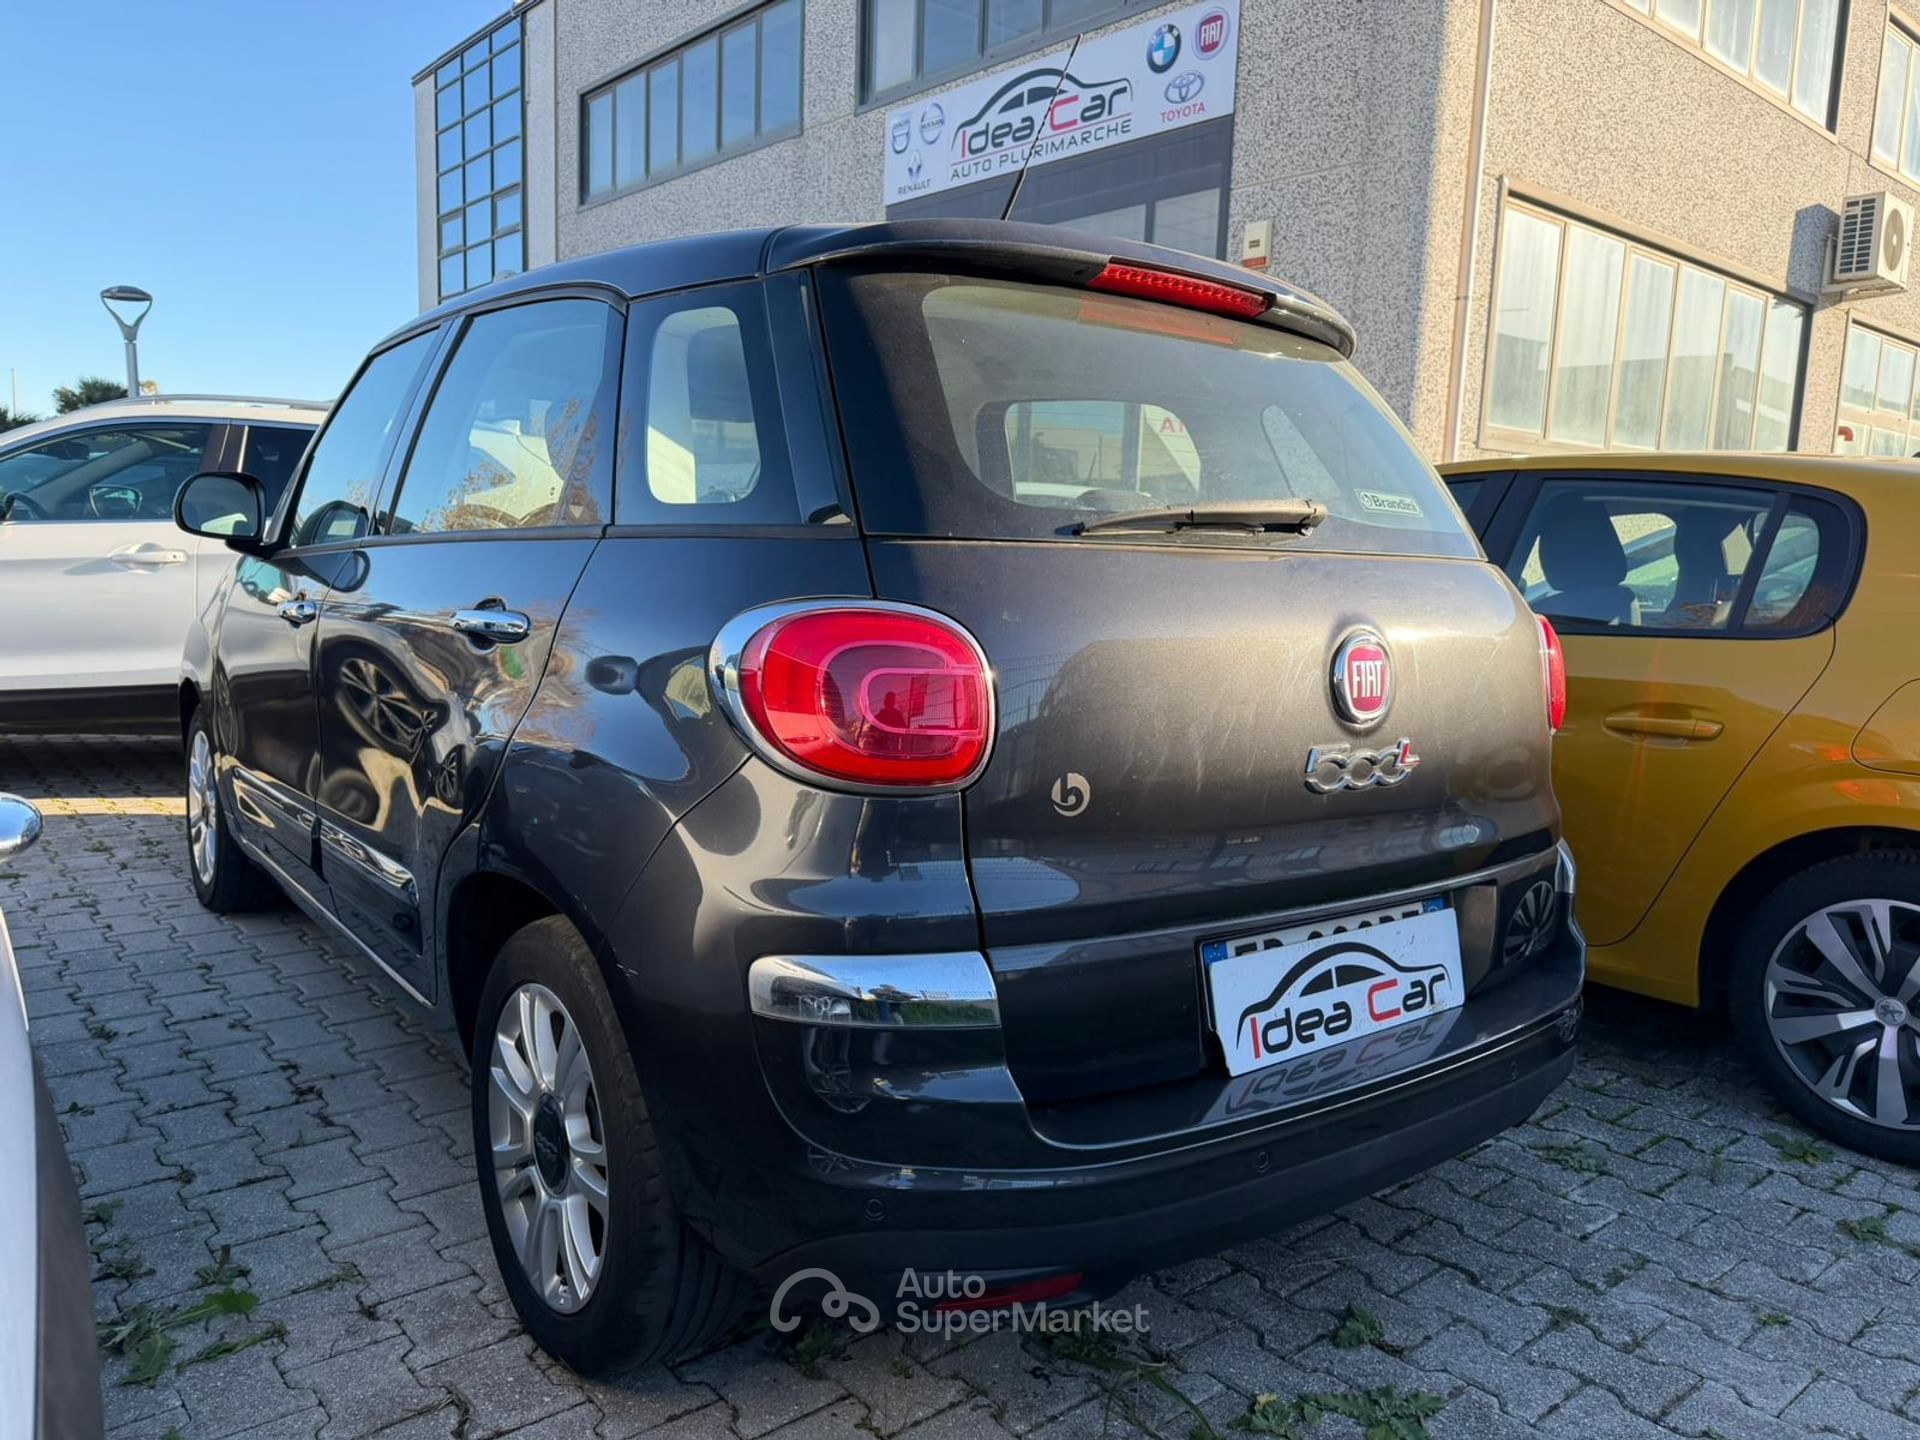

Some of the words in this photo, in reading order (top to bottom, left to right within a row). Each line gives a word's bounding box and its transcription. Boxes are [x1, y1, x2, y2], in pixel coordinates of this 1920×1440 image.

[1201, 20, 1222, 46] FIAT
[961, 116, 1034, 158] Idea
[1050, 86, 1128, 131] Car
[1161, 102, 1205, 122] TOYOTA
[950, 159, 992, 181] AUTO
[999, 119, 1132, 168] PLURIMARCHE
[898, 179, 931, 194] RENAULT
[1352, 660, 1383, 698] FIAT
[1250, 1000, 1352, 1059] Idea
[1367, 973, 1446, 1022] Car
